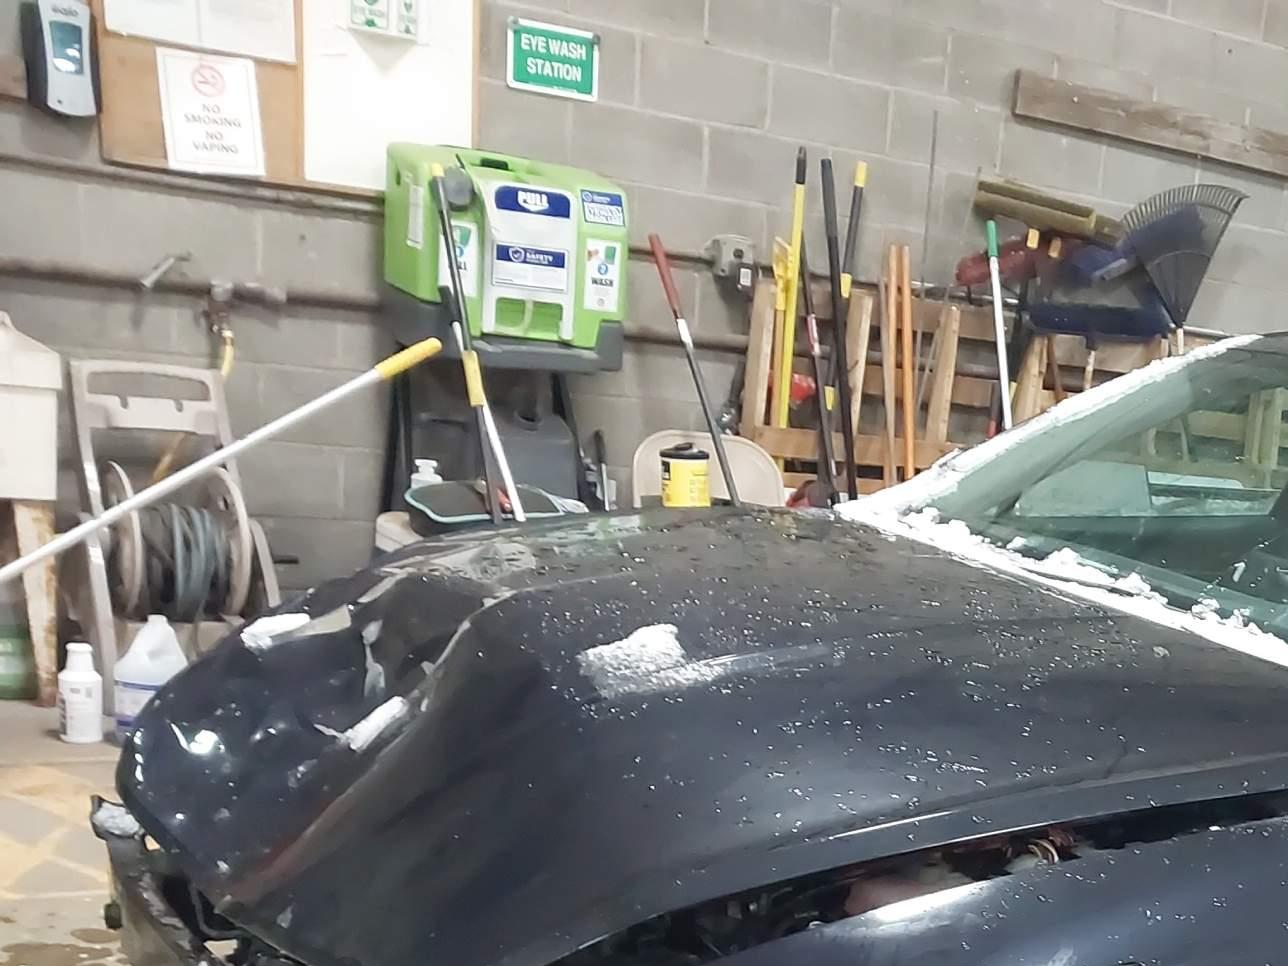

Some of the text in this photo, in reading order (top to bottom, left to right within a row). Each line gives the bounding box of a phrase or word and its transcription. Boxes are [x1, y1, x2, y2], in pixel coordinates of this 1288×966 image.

[520, 33, 587, 60] EYE WASH
[527, 57, 582, 82] STATION
[202, 103, 221, 114] NO
[184, 113, 241, 128] SMOKING
[205, 130, 223, 141] NO
[193, 141, 239, 154] VAPING
[518, 190, 549, 207] PULL
